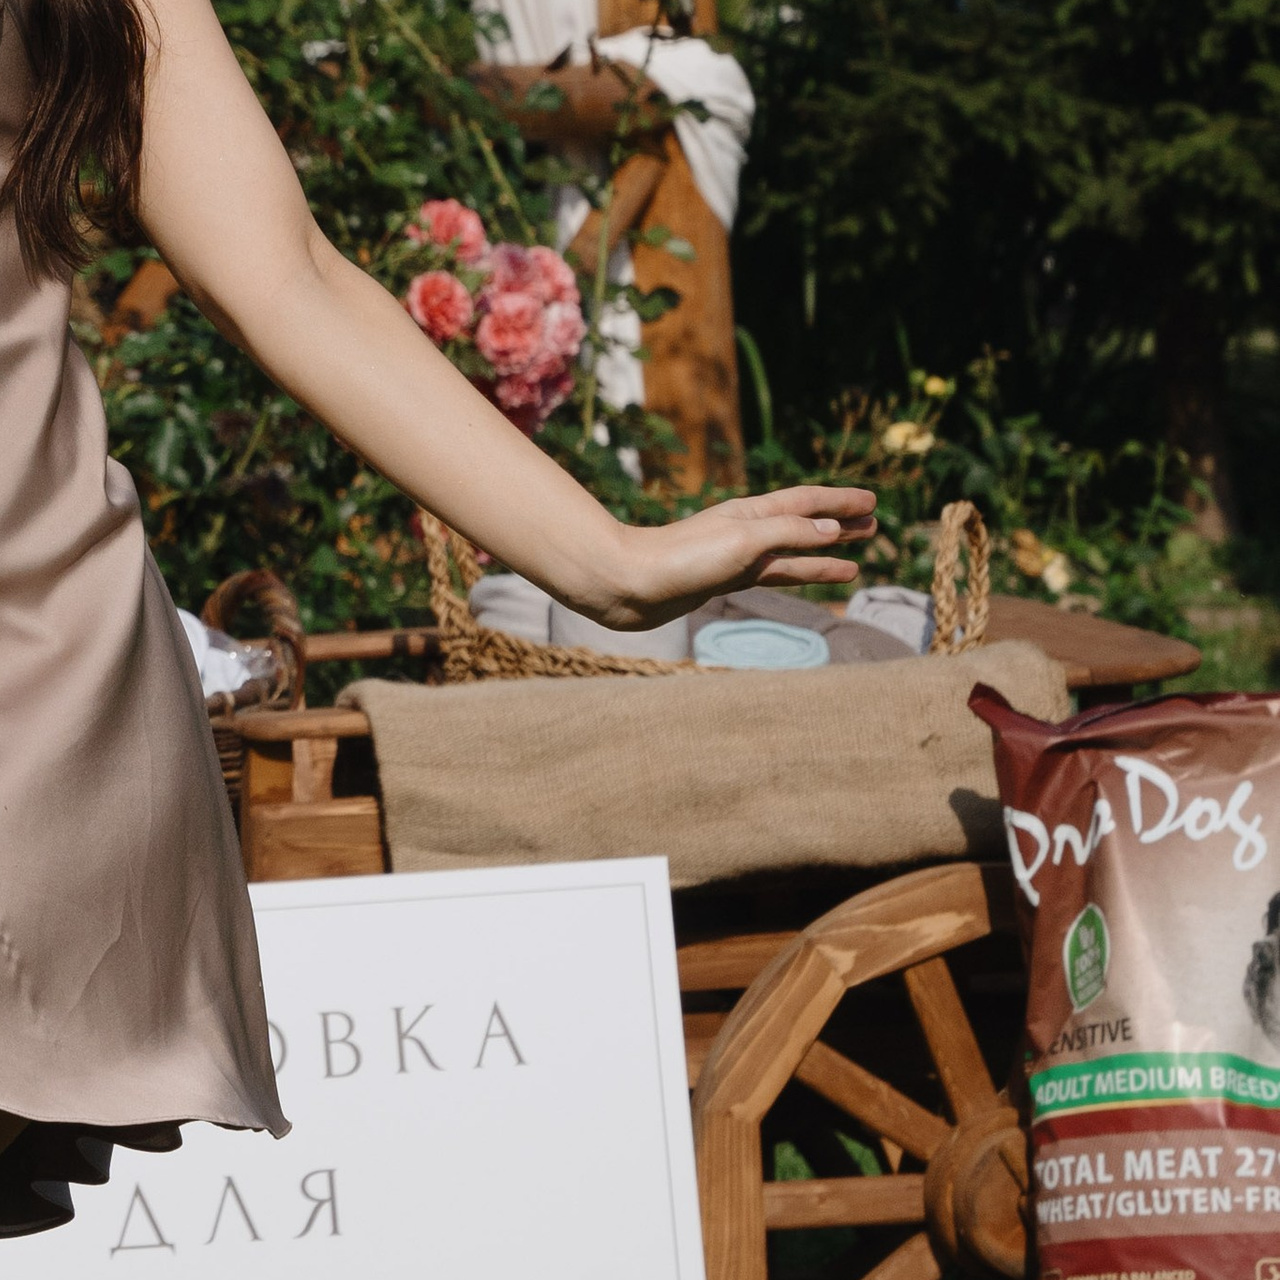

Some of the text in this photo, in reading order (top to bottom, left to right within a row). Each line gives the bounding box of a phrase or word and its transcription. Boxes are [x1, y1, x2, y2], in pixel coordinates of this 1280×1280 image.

[1114, 755, 1268, 872] Dog
[269, 1000, 529, 1079] ВКА
[1047, 1017, 1133, 1056] ENSITIVE
[1035, 1066, 1280, 1106] ADULT MEDIUM BREED
[1034, 1146, 1280, 1190] TOTAL MEAT 27
[109, 1168, 344, 1259] ДЛЯ
